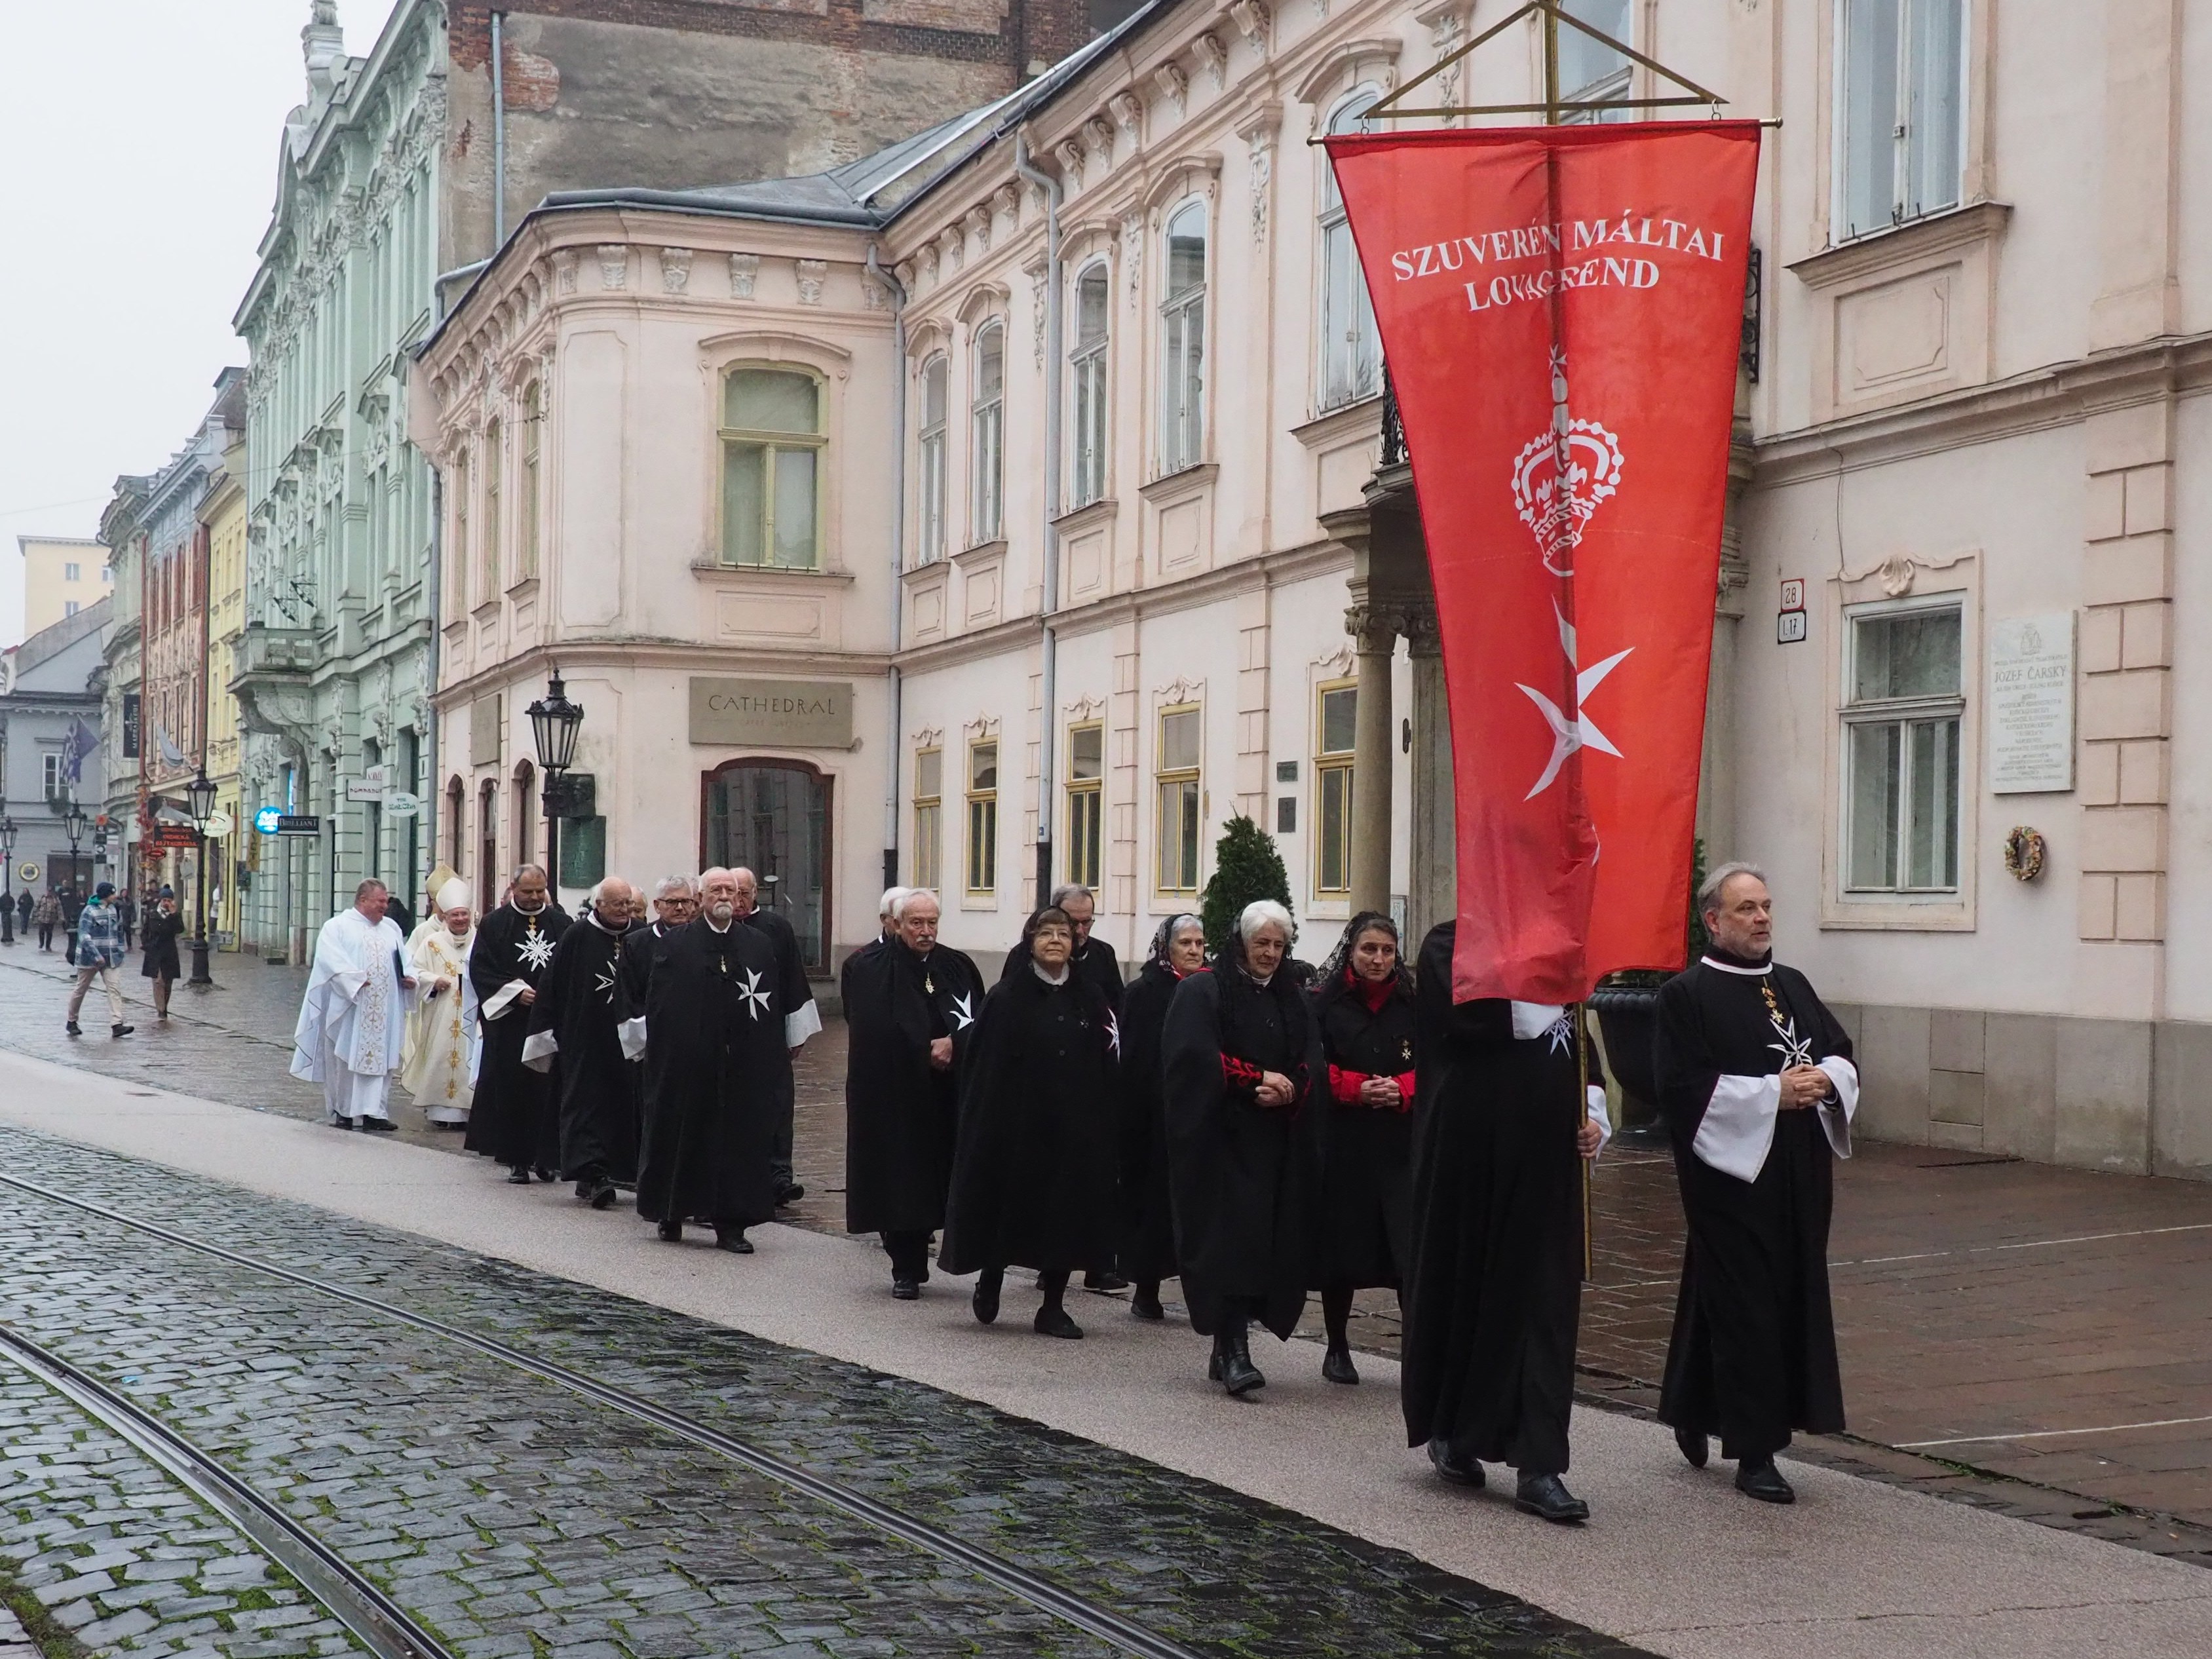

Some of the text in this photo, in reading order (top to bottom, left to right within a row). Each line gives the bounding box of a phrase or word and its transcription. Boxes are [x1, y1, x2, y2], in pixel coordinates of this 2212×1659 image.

[1391, 208, 1725, 281] SZUVERÉN MÁLTAI
[1462, 257, 1660, 311] LOVAGREND
[1785, 587, 1796, 603] 28
[708, 695, 835, 715] CATHEDRAL
